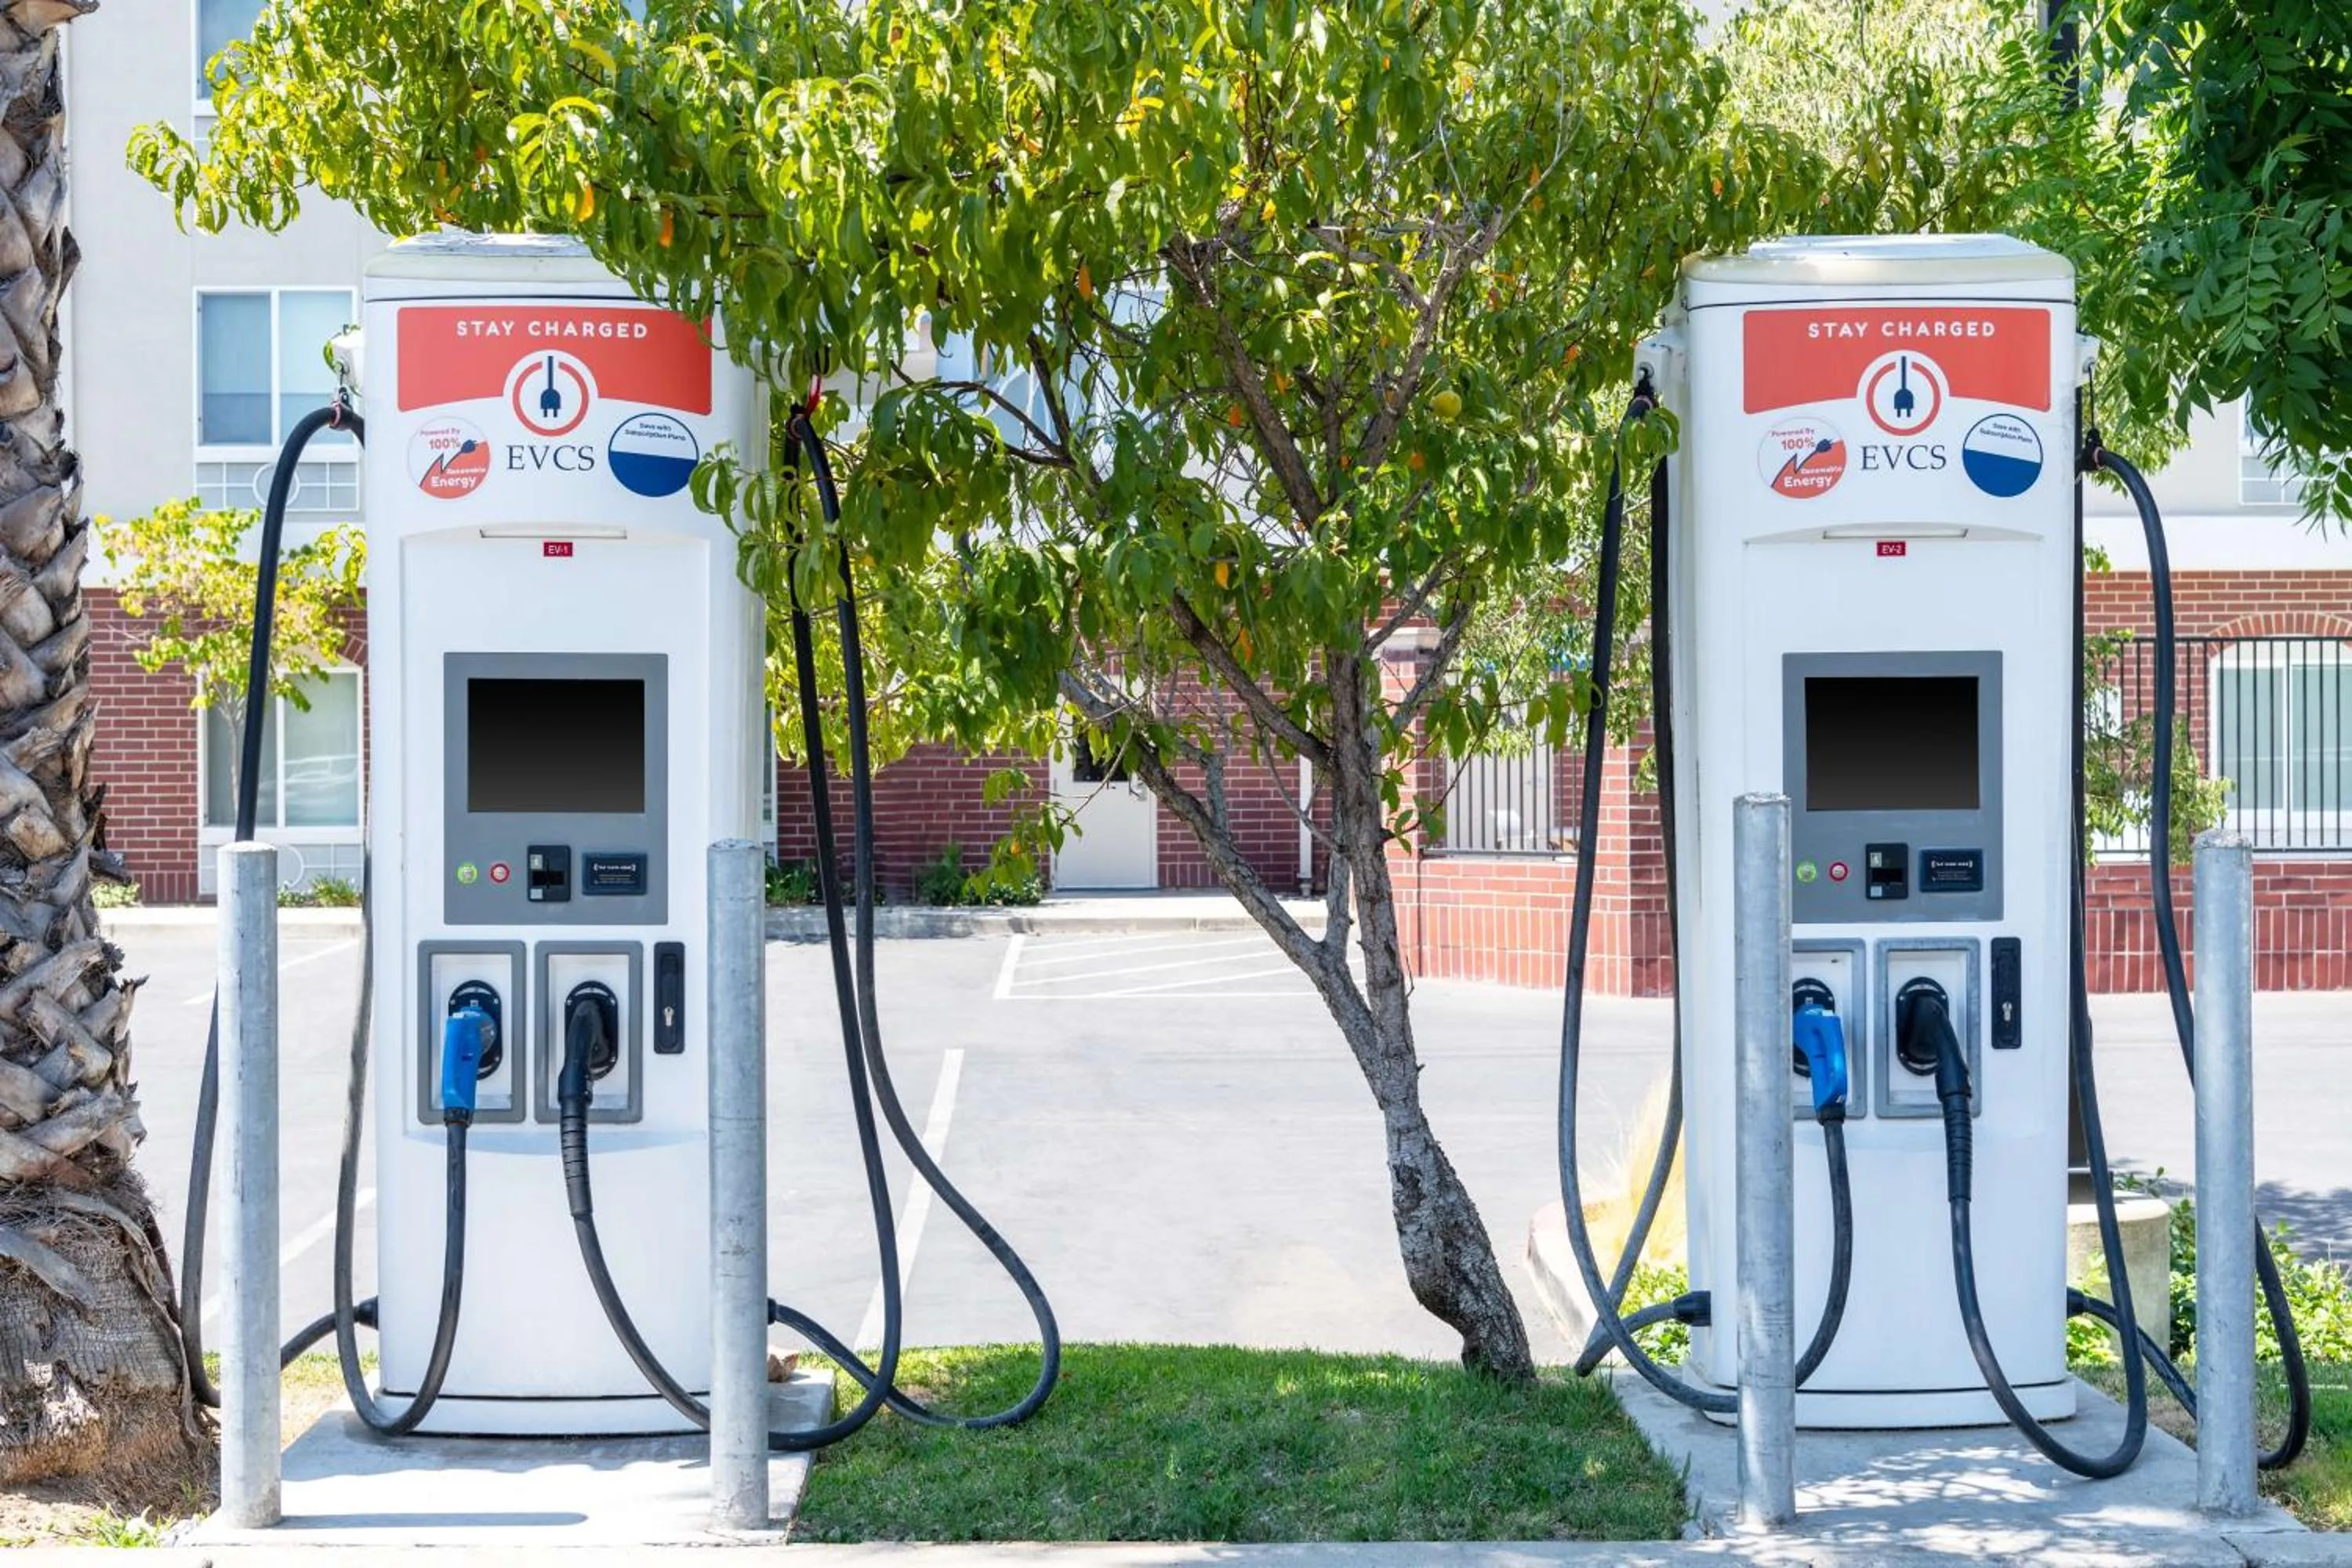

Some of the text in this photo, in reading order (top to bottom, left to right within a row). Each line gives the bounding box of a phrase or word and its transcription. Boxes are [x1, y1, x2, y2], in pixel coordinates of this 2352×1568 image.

[456, 320, 648, 339] STAY CHARGED
[1808, 321, 1995, 339] STAY CHARGED
[429, 437, 461, 450] 100%
[1781, 437, 1817, 450] 100%
[506, 445, 595, 471] EVCS
[1860, 445, 1947, 470] EVCS
[430, 475, 477, 489] Energy
[1783, 475, 1833, 488] Energy
[548, 545, 569, 554] EV-1
[1882, 545, 1902, 554] EV-2
